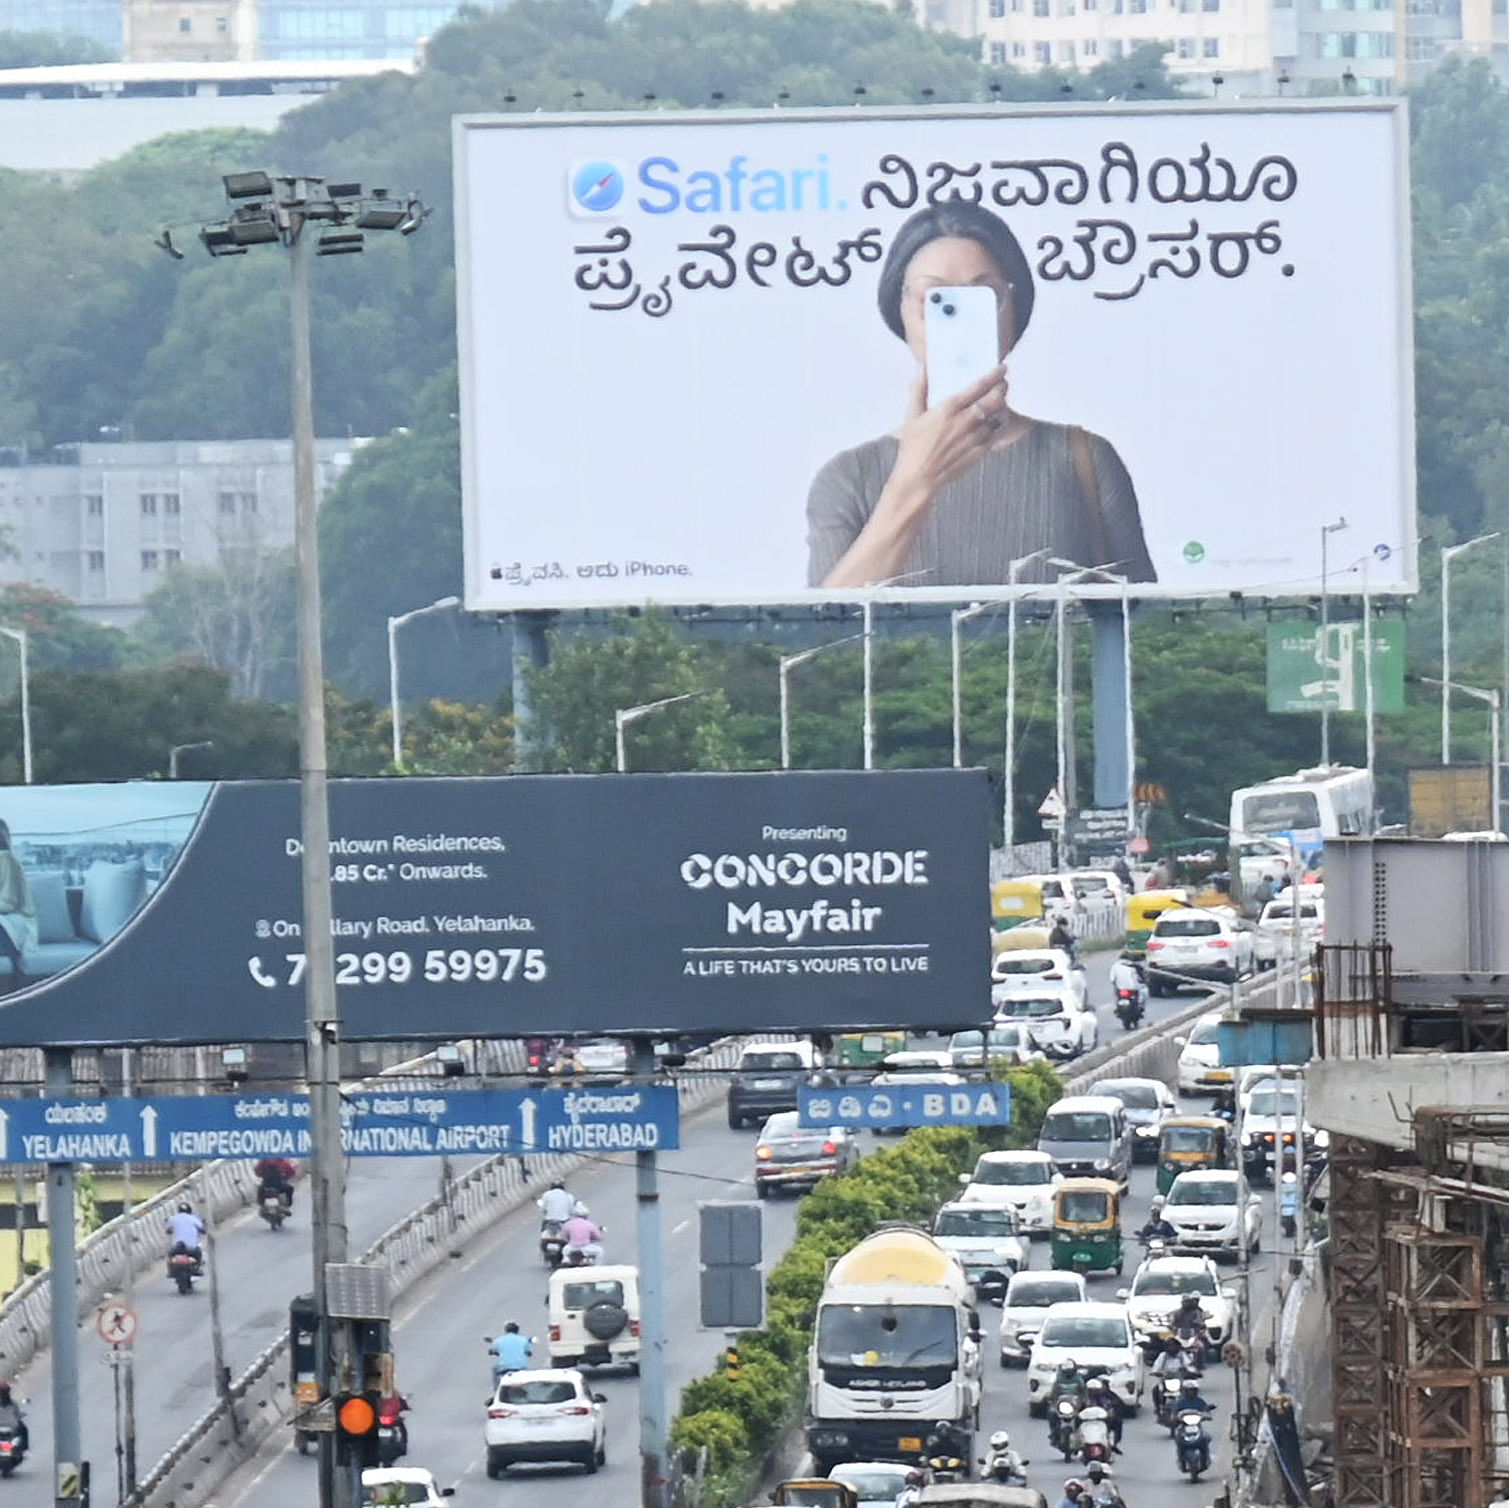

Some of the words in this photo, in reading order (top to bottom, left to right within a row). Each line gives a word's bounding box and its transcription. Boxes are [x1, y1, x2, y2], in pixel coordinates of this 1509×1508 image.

[762, 826, 847, 842] Presenting
[286, 839, 388, 855] Dntown
[400, 863, 488, 880] Onwards.
[681, 851, 929, 888] CONCORDE
[273, 920, 301, 936] On
[727, 899, 882, 942] Mayfair
[424, 949, 546, 982] 59975
[683, 960, 696, 975] A
[699, 960, 735, 975] LIFE
[741, 958, 798, 974] THAT'S
[801, 957, 860, 973] YOURS
[863, 957, 887, 972] TO
[891, 956, 928, 972] LIVE
[923, 1093, 998, 1116] BDA
[22, 1134, 131, 1159] YELAHANKA
[170, 1131, 294, 1155] KEMPEGOWDA
[298, 1127, 432, 1152] INRNATIONAL
[436, 1125, 510, 1148] AIRPORT
[548, 1124, 659, 1147] HYDERABAD
